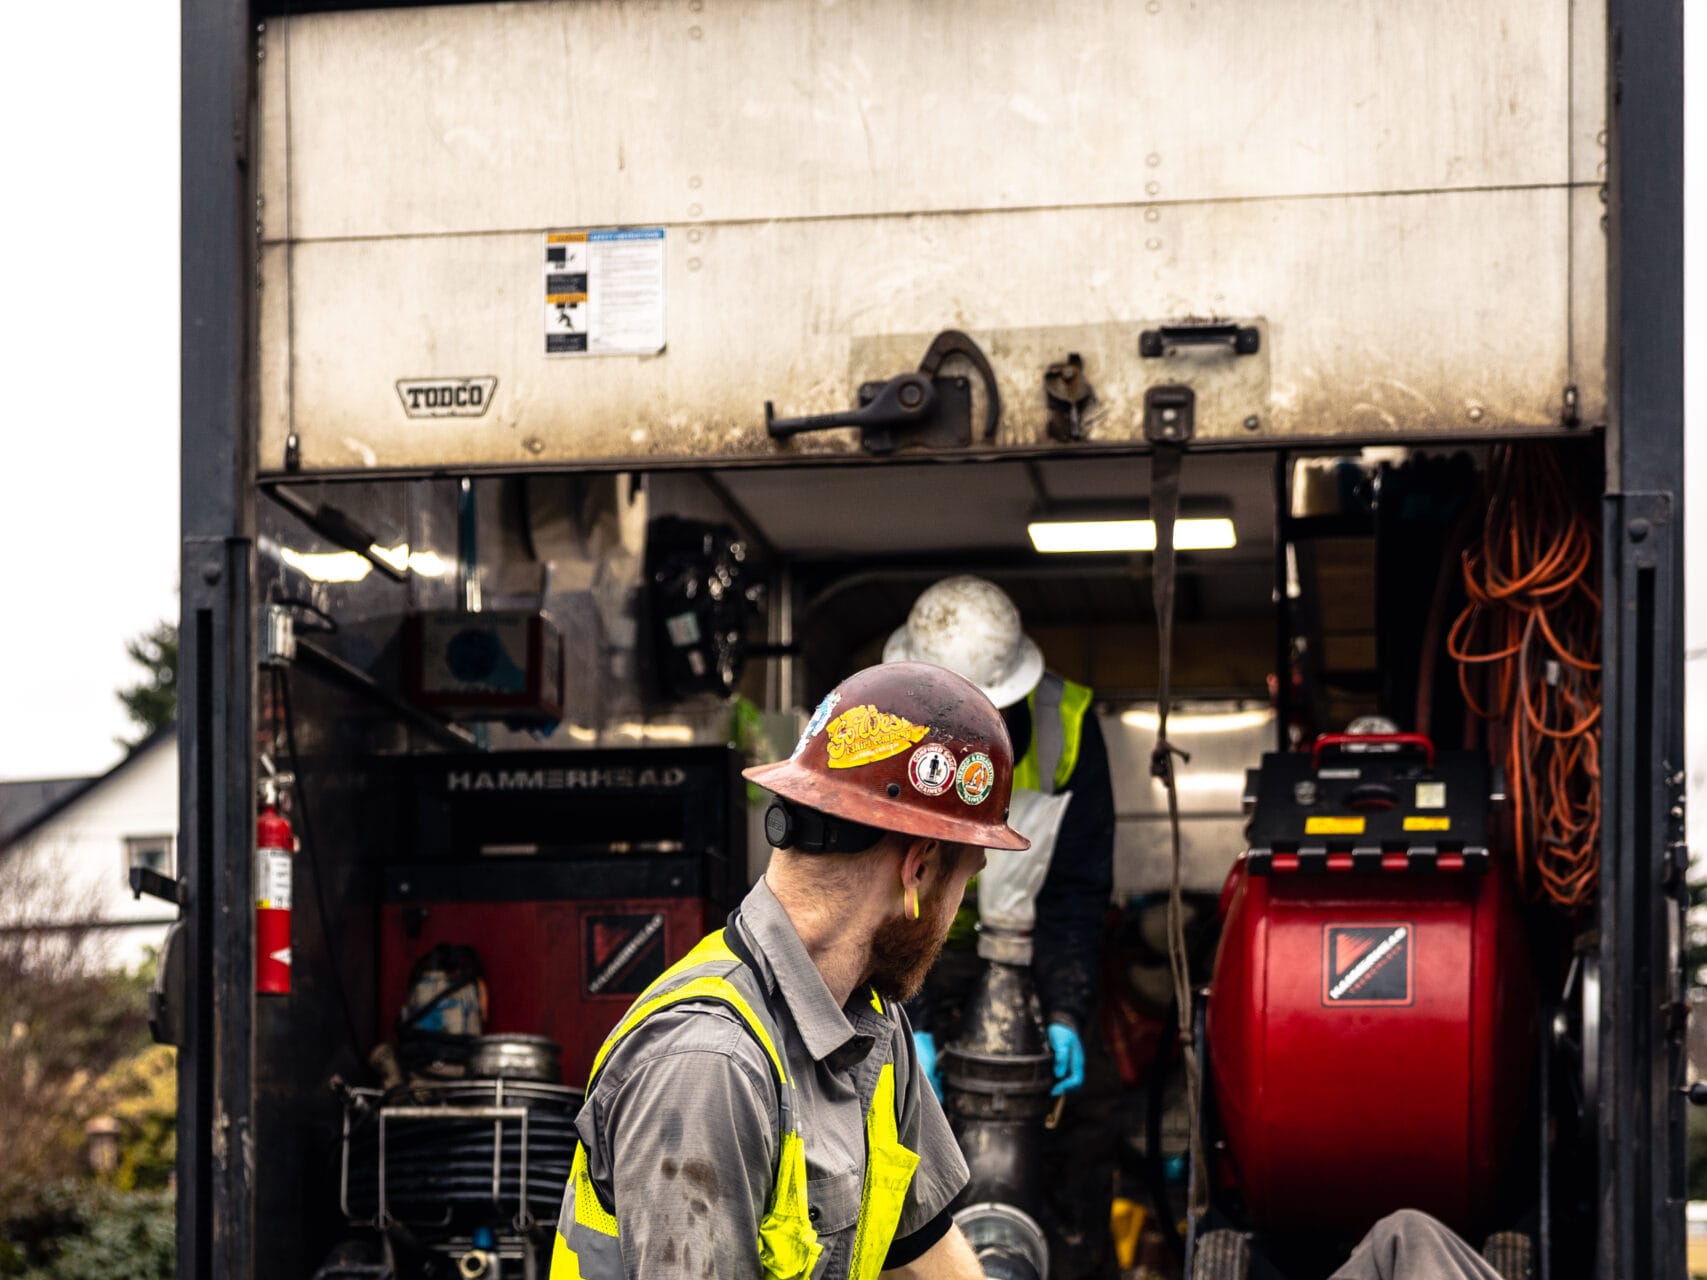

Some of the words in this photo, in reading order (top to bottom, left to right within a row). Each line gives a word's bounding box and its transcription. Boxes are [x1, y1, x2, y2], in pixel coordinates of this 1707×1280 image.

[407, 385, 482, 408] TODCO
[913, 745, 944, 763] CONFINED
[449, 767, 686, 791] HAMMERHEAD
[916, 782, 943, 794] TRAINED
